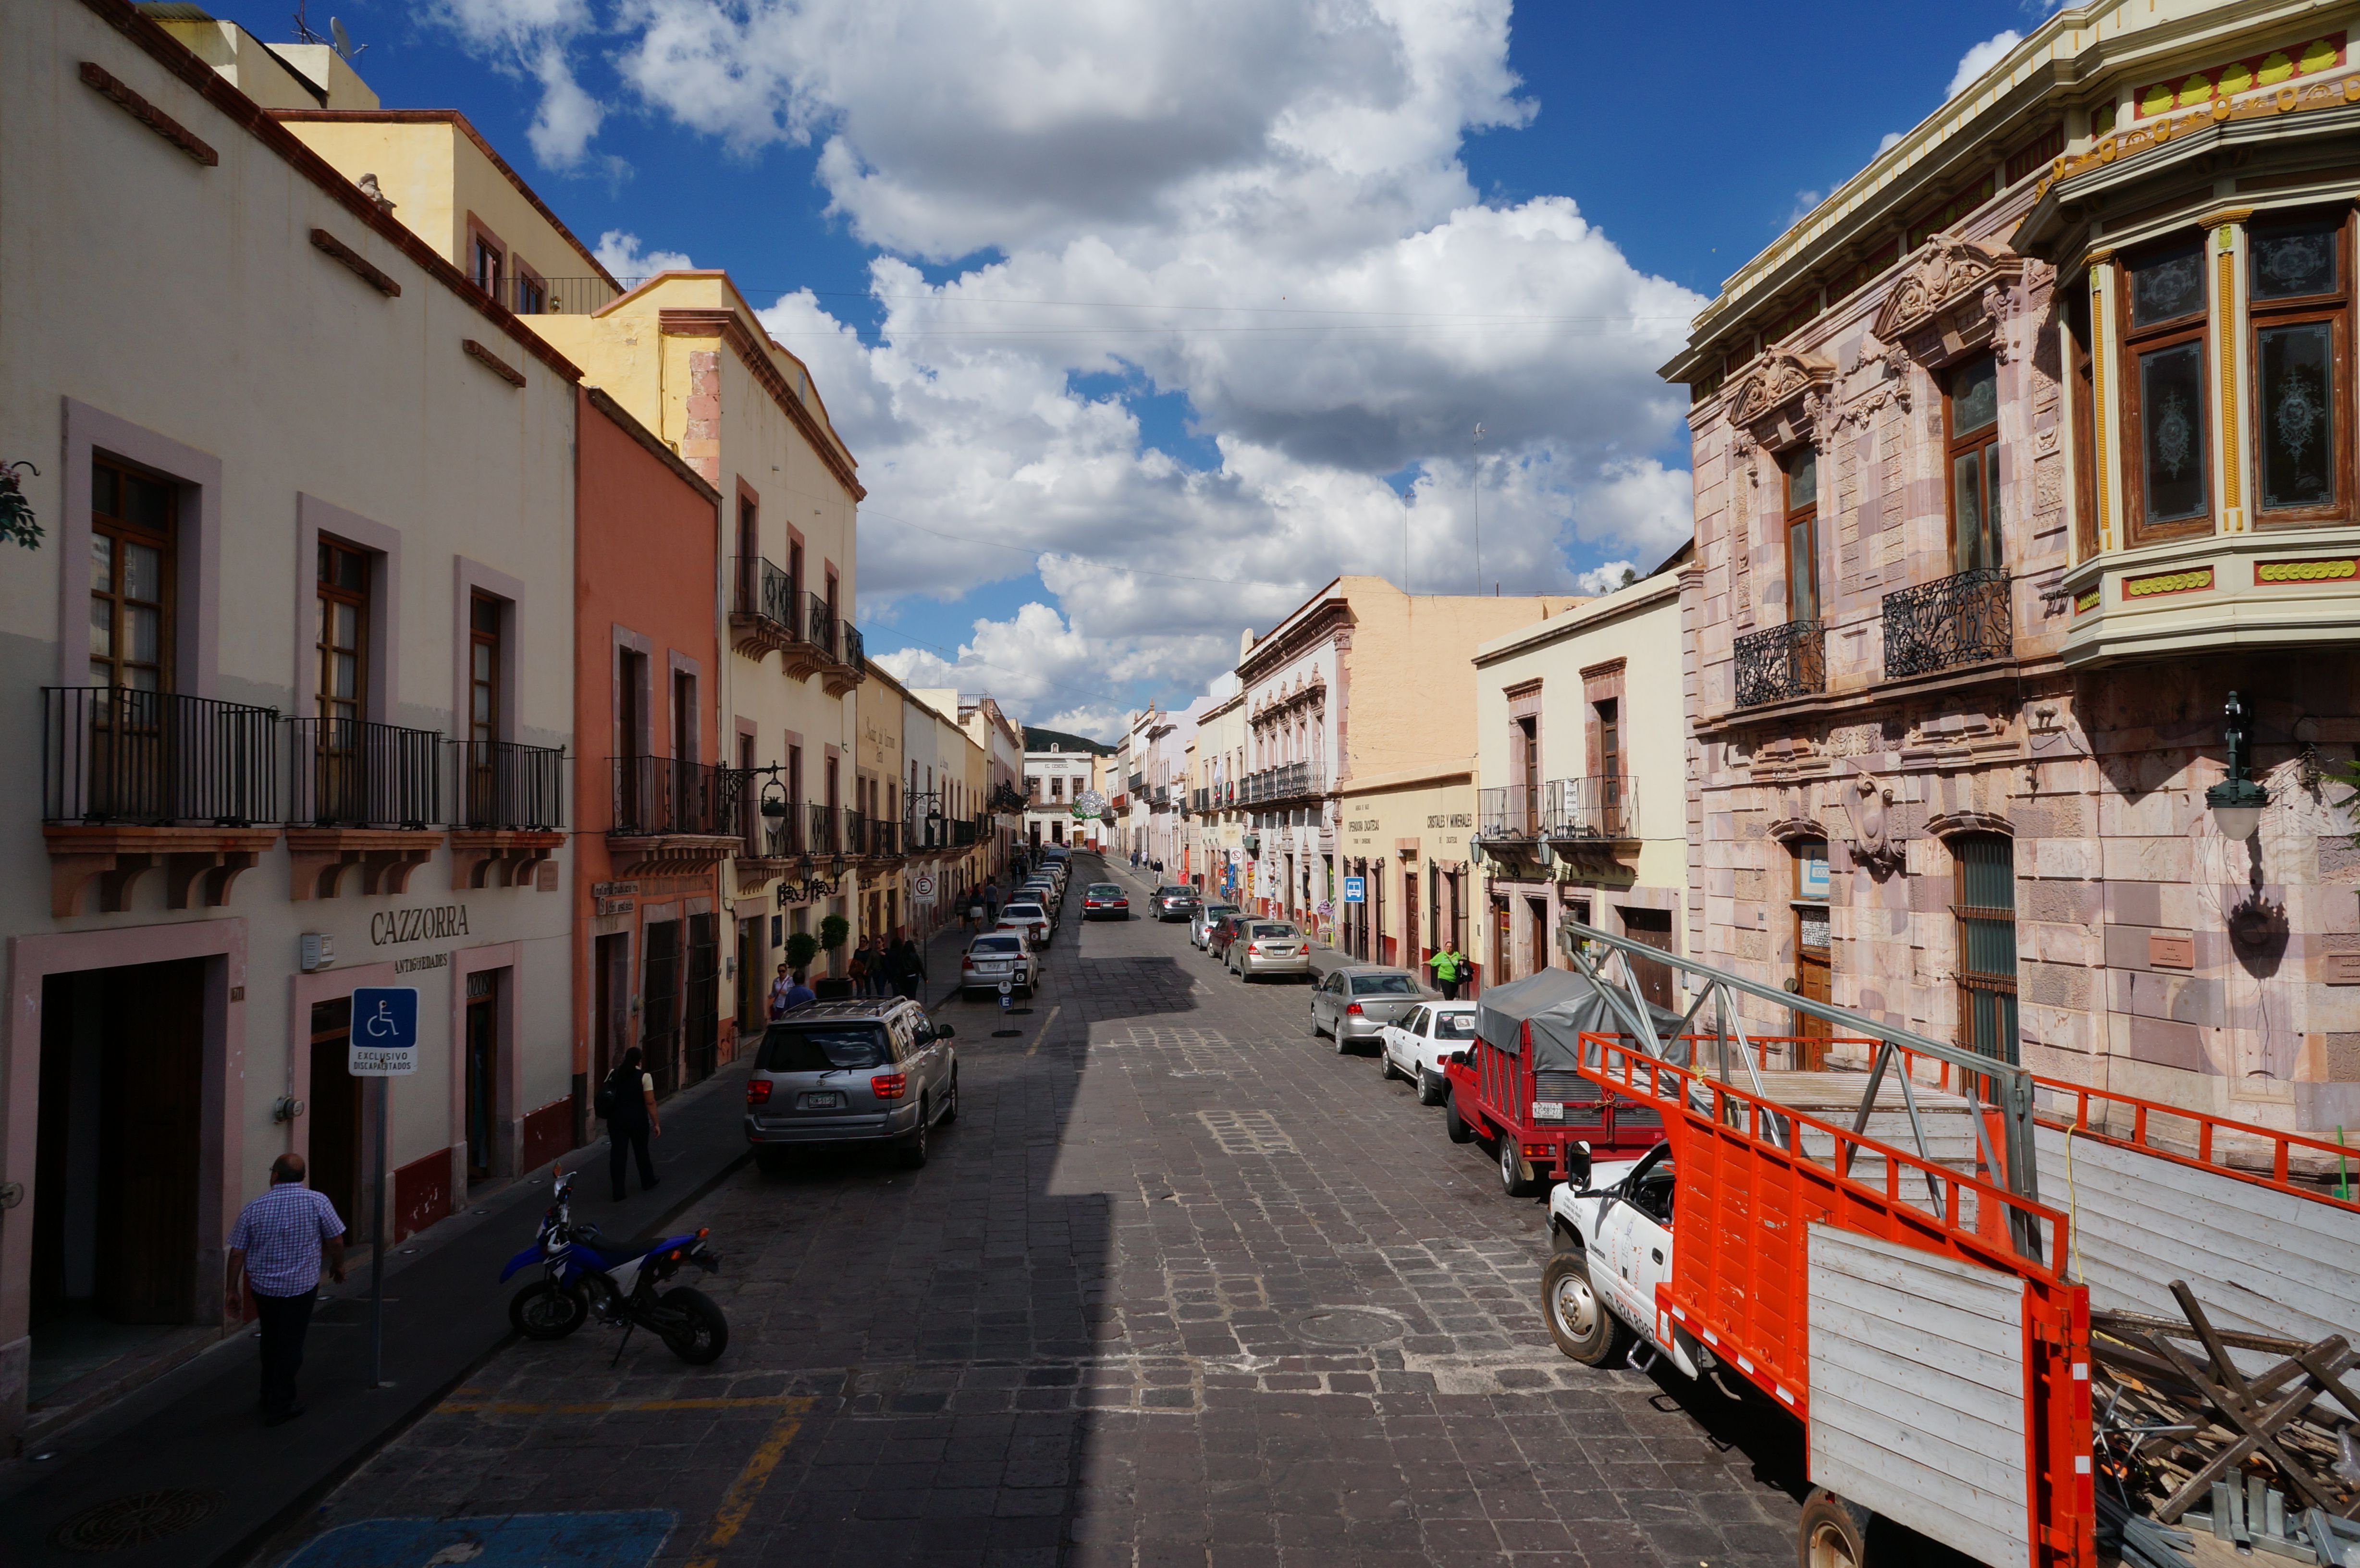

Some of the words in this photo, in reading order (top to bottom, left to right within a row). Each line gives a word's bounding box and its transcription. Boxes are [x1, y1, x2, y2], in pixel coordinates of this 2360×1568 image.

[1348, 821, 1363, 833] OPERADORA
[1364, 819, 1379, 832] ZACATECAS
[1427, 815, 1445, 829] CRISTALES
[1446, 814, 1450, 828] Y
[1450, 813, 1472, 828] MINERALES
[920, 881, 928, 891] E
[371, 905, 469, 946] CAZZORRA
[1002, 997, 1009, 1006] E
[357, 1052, 407, 1060] EXCLUSIVO
[354, 1061, 411, 1070] DISCAPACITADOS
[1616, 1298, 1634, 1325] 924
[1634, 1313, 1655, 1344] 8987
